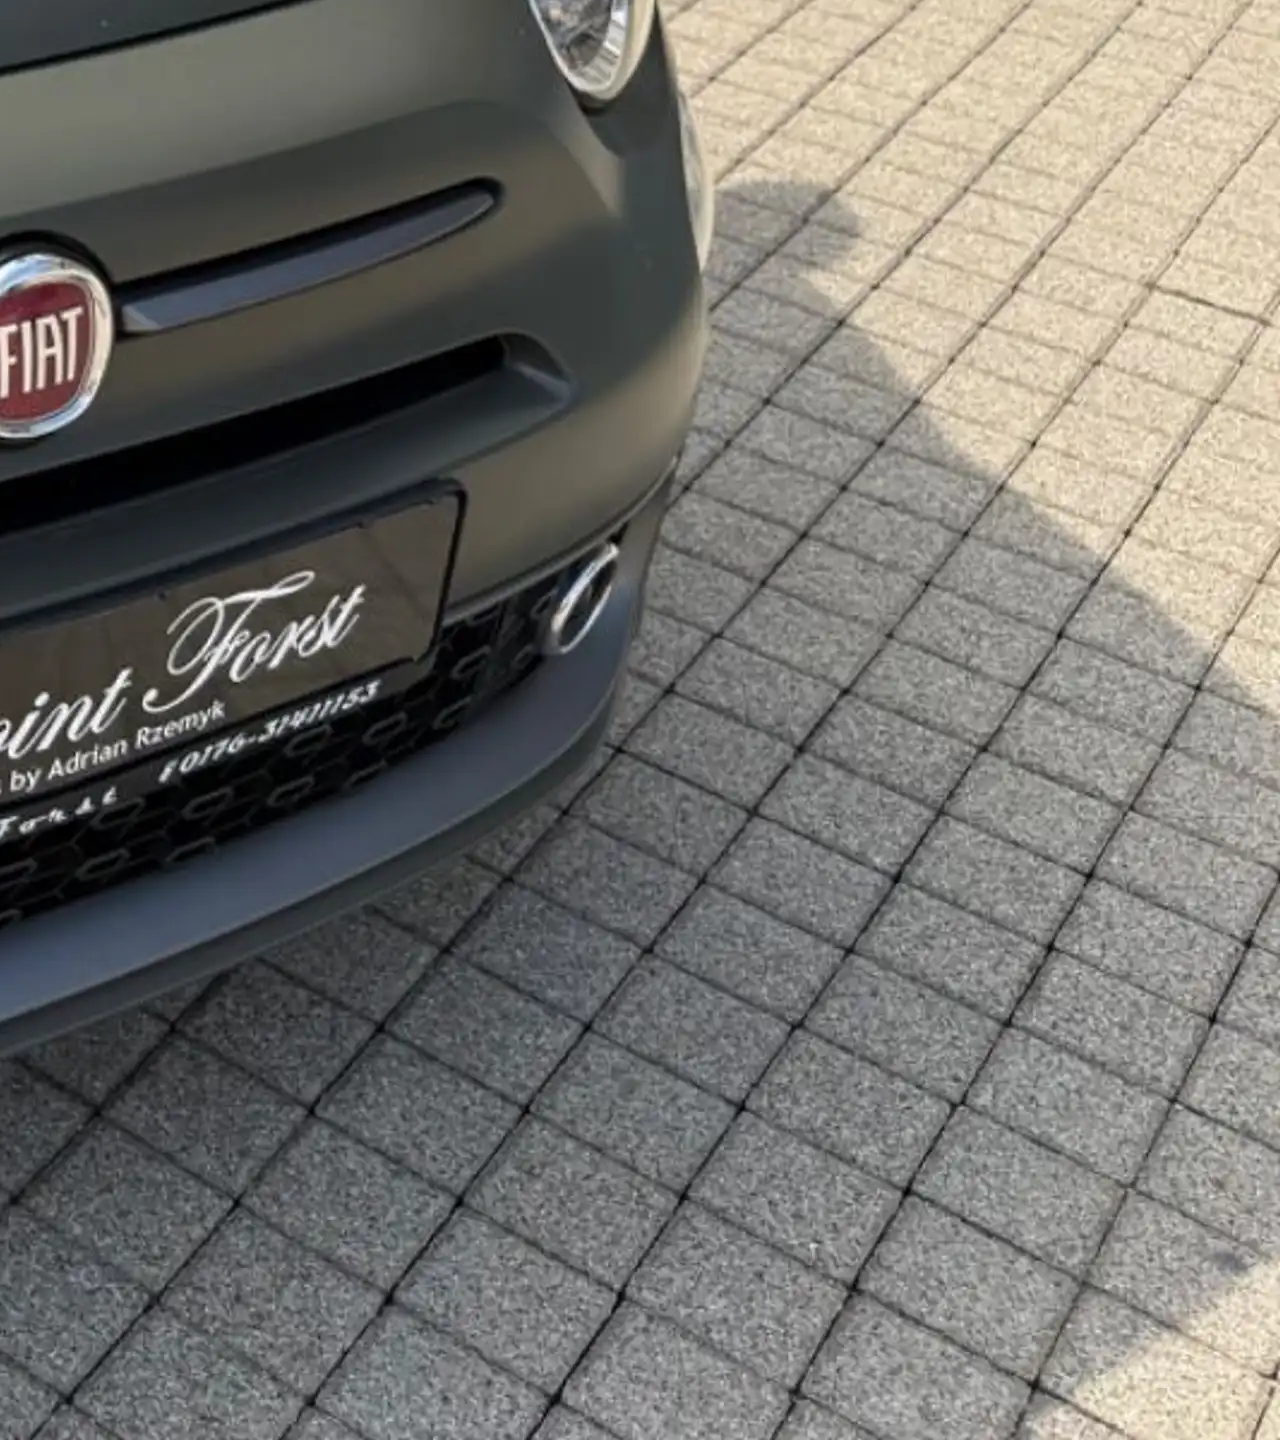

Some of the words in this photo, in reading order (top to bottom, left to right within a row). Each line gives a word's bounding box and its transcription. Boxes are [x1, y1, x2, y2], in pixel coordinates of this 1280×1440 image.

[142, 569, 366, 713] Forst
[10, 766, 41, 793] by
[48, 738, 129, 781] Adrian
[135, 699, 227, 750] Rzemyk
